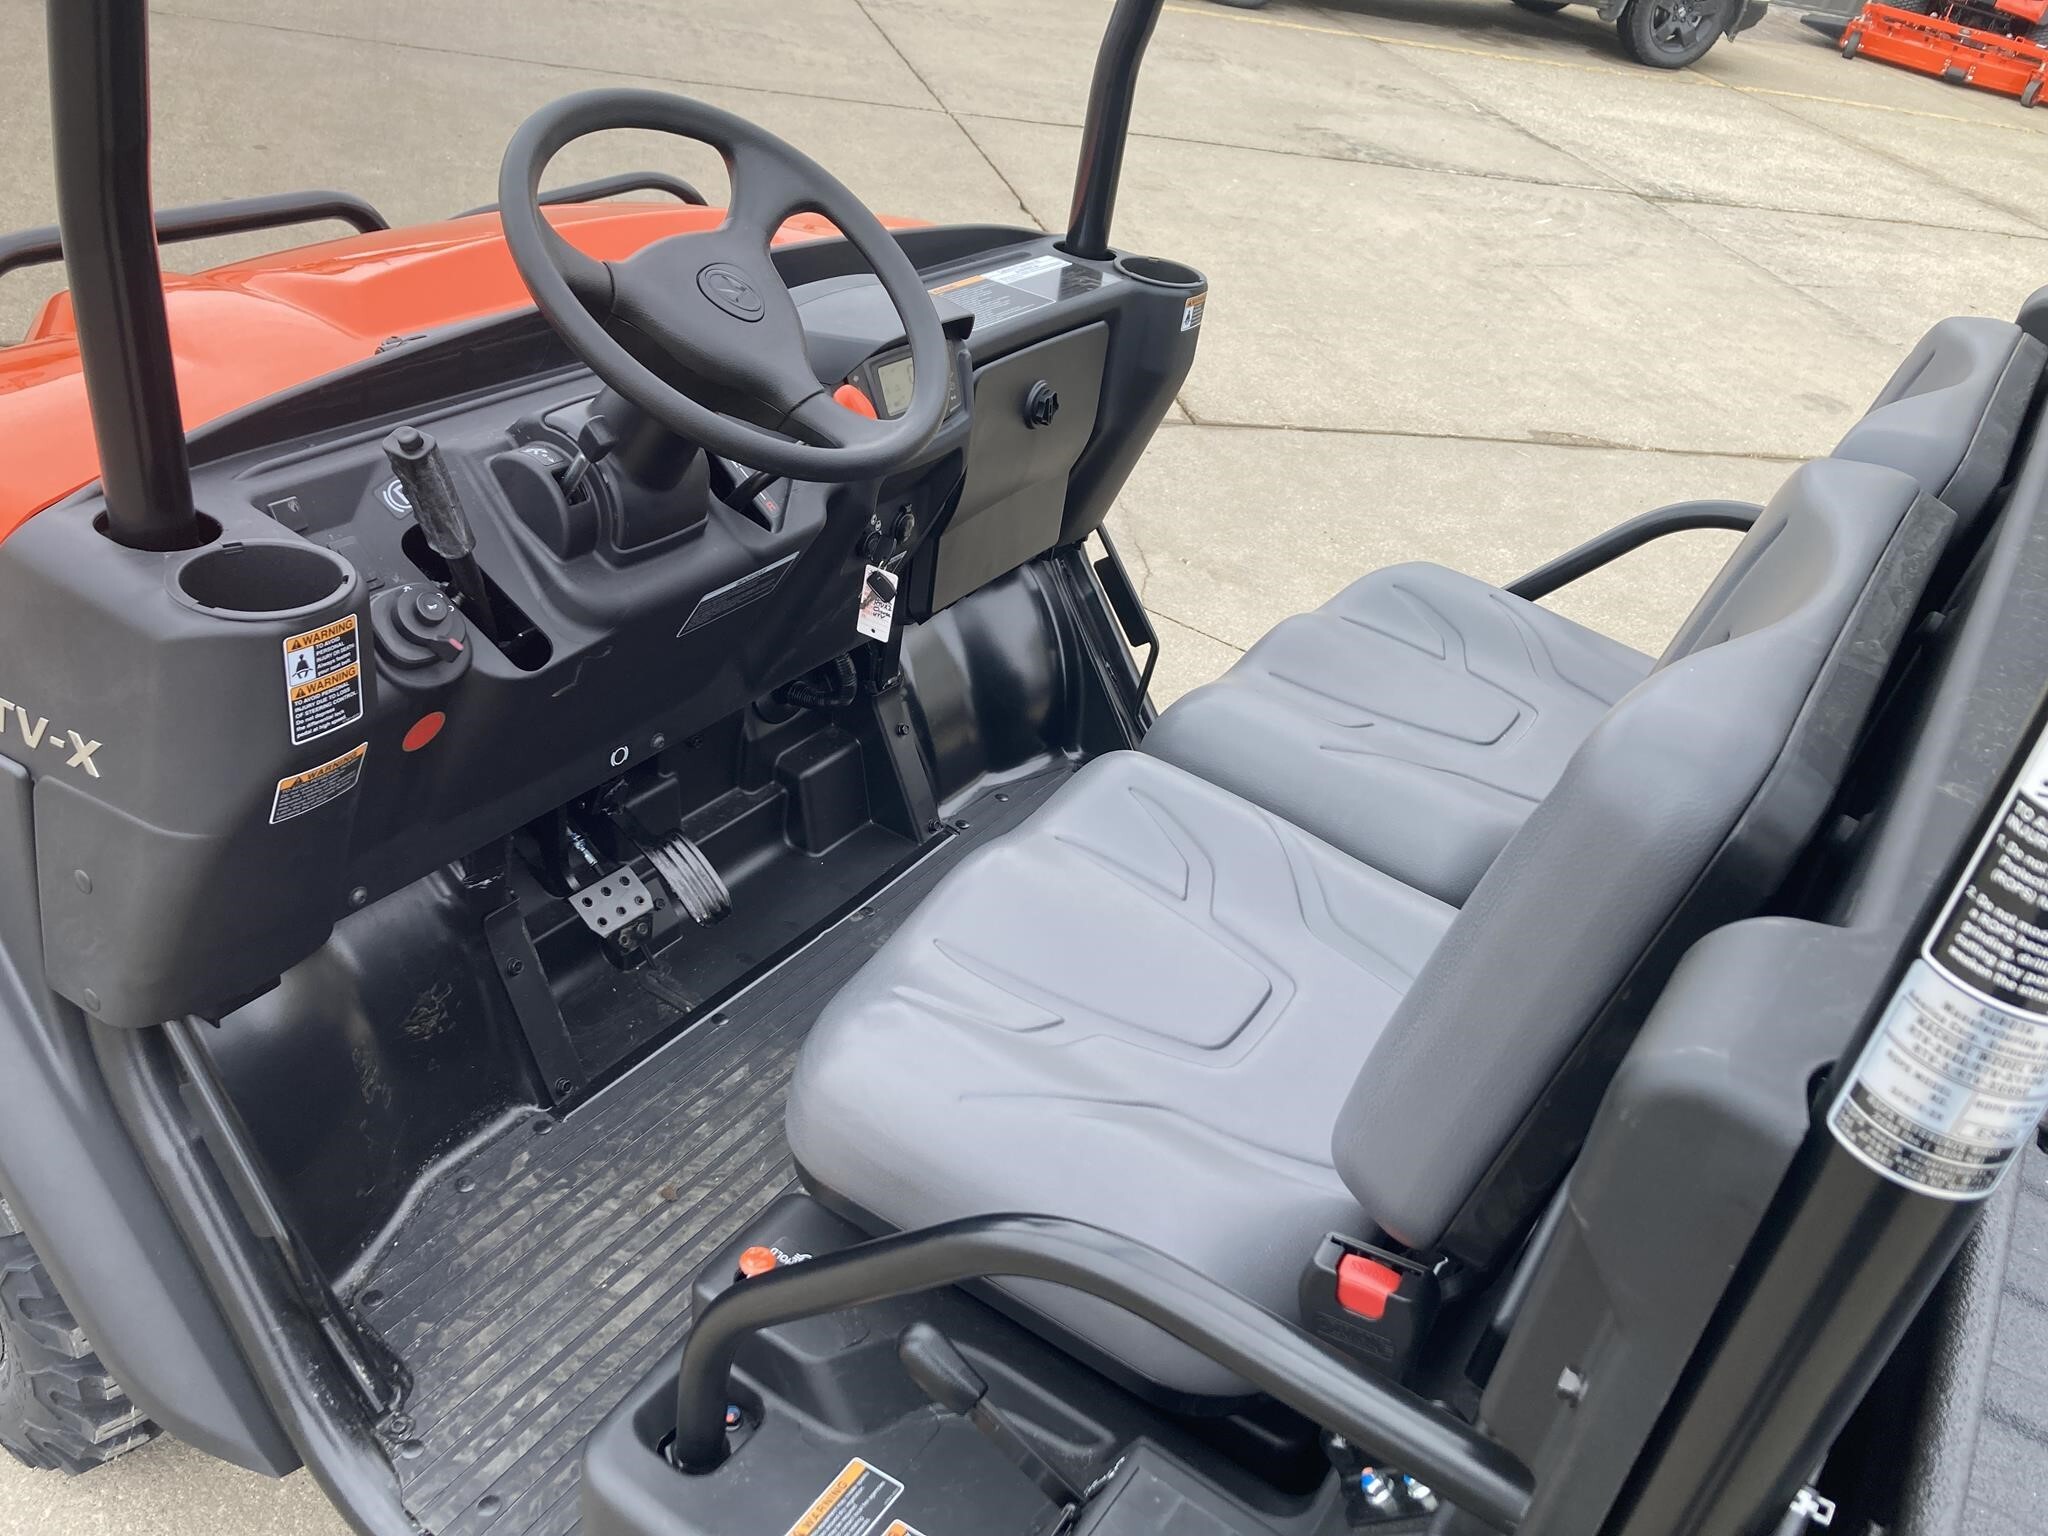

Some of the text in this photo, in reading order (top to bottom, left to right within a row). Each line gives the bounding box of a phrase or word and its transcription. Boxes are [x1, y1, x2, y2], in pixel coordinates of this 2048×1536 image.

[302, 620, 353, 646] WARNING
[307, 667, 356, 693] WARNING
[294, 702, 316, 712] INJURY
[316, 697, 328, 706] DUE
[337, 687, 351, 697] LOSS
[304, 694, 320, 704] AVOID
[322, 682, 350, 696] PERSONAL
[305, 702, 332, 716] STEERING
[2015, 799, 2035, 823] TO
[1990, 868, 2038, 905] (ROPS)
[1968, 907, 1980, 920] a
[1978, 911, 2018, 943] ROPS
[1993, 907, 2018, 928] not
[1993, 971, 2018, 993] the
[1996, 959, 2026, 981] any
[803, 1480, 848, 1528] WARNING
